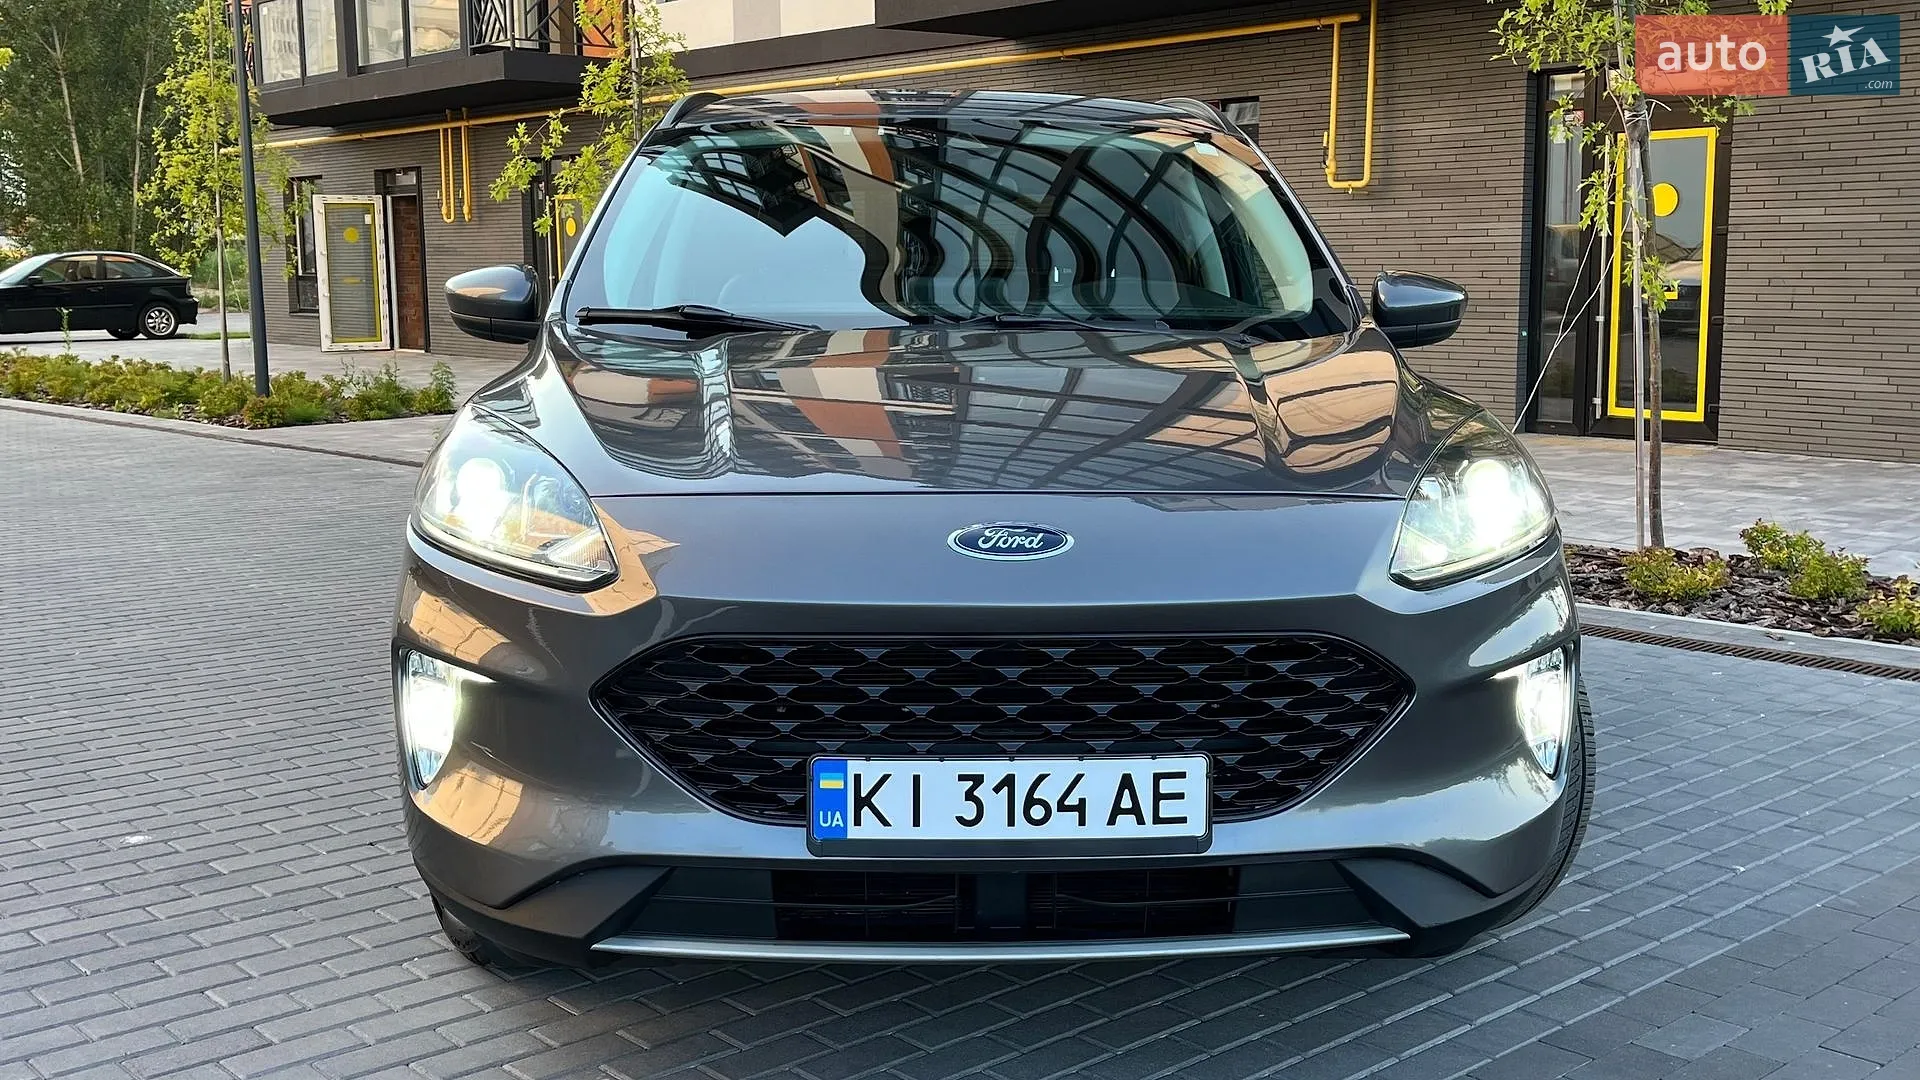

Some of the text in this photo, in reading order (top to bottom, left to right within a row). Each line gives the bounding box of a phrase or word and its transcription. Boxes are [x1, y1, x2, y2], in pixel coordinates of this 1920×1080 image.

[978, 527, 1043, 549] Ford
[955, 772, 1087, 828] 3164
[1106, 771, 1188, 827] AE
[819, 810, 844, 827] UA
